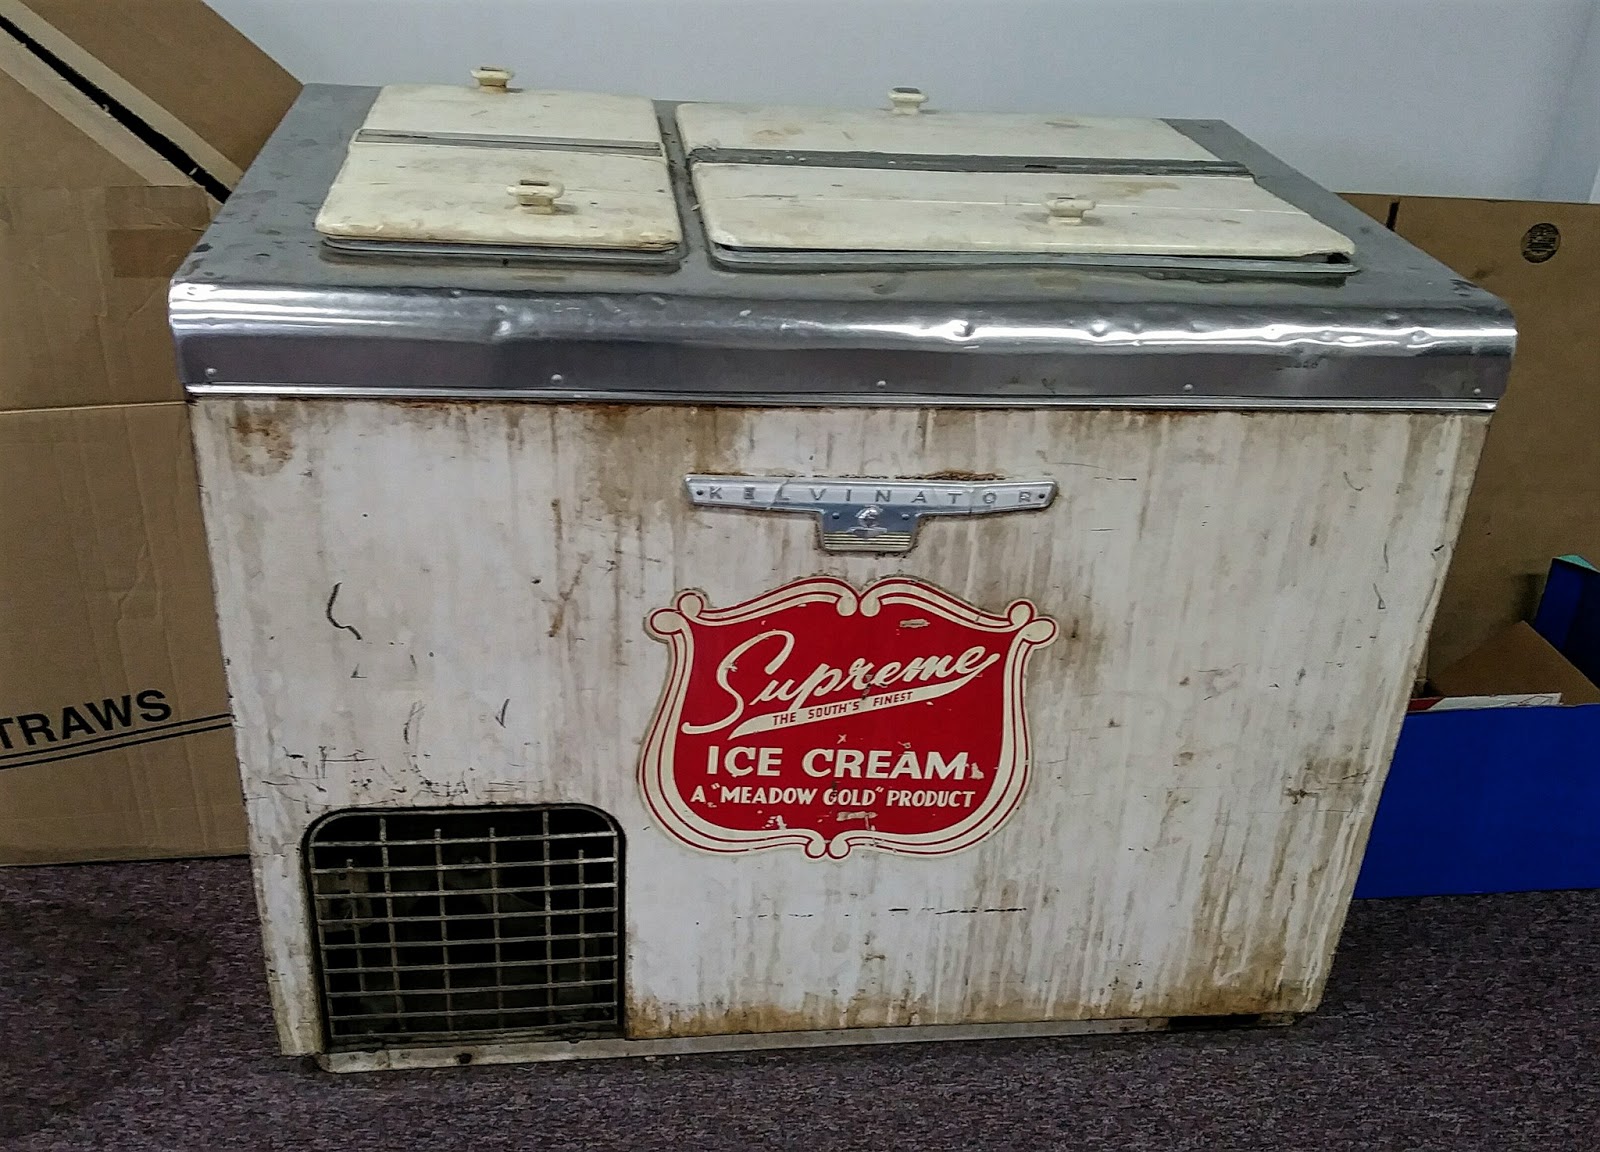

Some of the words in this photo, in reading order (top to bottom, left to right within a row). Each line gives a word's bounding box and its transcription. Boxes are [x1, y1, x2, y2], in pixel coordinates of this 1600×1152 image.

[708, 485, 1032, 504] KELVINATOR
[681, 629, 1000, 735] Supreme
[772, 711, 797, 727] THE
[807, 700, 860, 720] SOUTH'S
[872, 690, 914, 709] FINEST
[707, 745, 783, 779] ICE
[801, 747, 970, 781] CREAM
[690, 785, 706, 804] A
[886, 790, 976, 808] PRODUCT
